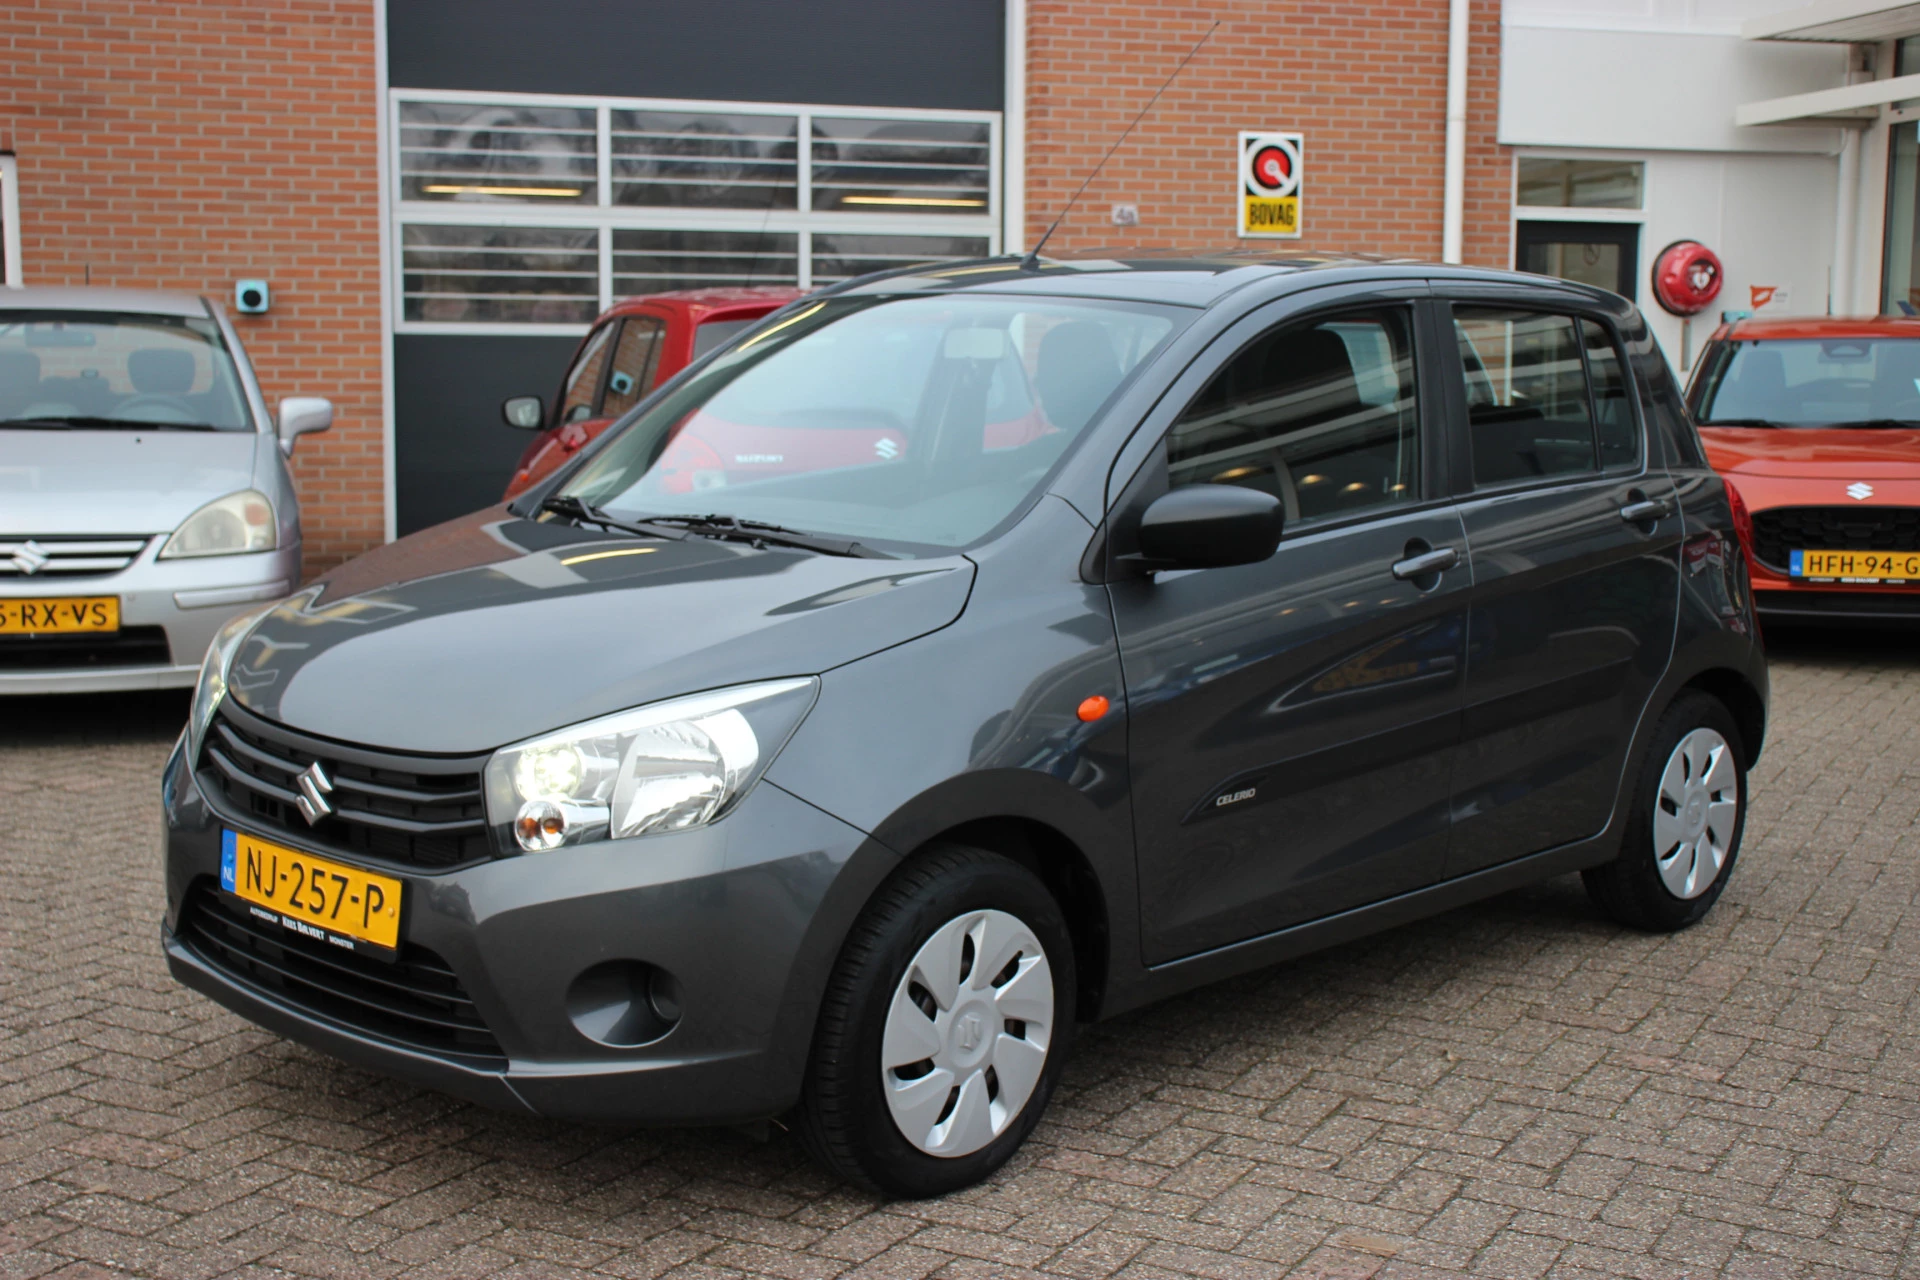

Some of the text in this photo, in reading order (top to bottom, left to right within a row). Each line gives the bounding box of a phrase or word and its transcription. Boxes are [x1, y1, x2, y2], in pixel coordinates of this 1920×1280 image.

[1250, 204, 1294, 226] BOVAG
[1809, 555, 1918, 575] HFH-94-G
[1216, 787, 1256, 806] CELERIO
[223, 866, 234, 882] NL
[246, 846, 385, 929] NJ-257-P
